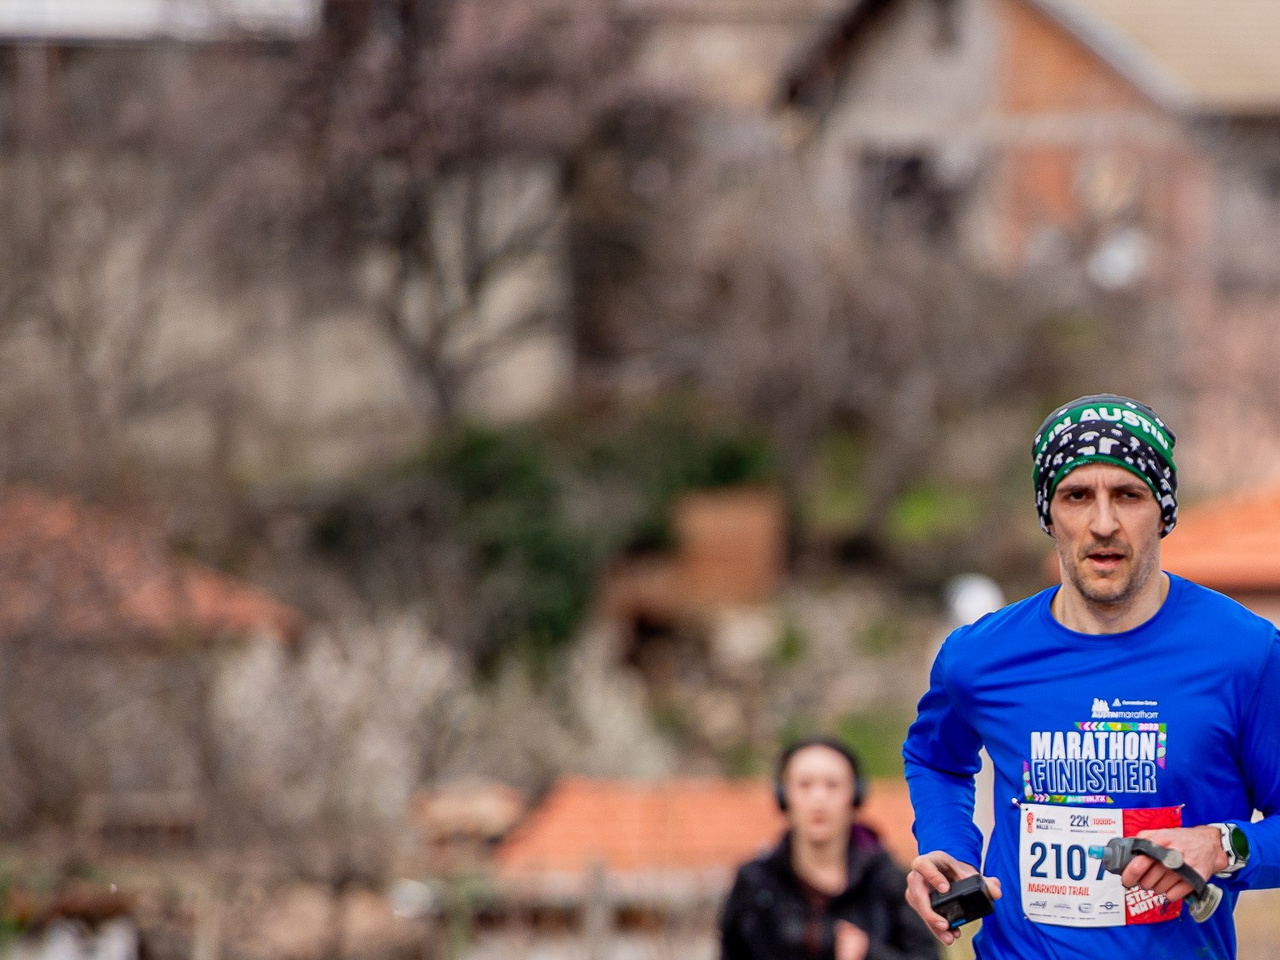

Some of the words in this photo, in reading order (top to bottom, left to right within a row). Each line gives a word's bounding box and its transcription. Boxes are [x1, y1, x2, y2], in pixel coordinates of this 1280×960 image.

[1079, 407, 1169, 450] AUSTIN
[1030, 731, 1156, 760] MARATHON
[1031, 760, 1157, 793] FINISHER
[1070, 814, 1090, 827] 22K
[1027, 882, 1067, 895] MARKOVO
[1068, 885, 1090, 896] TRAIL
